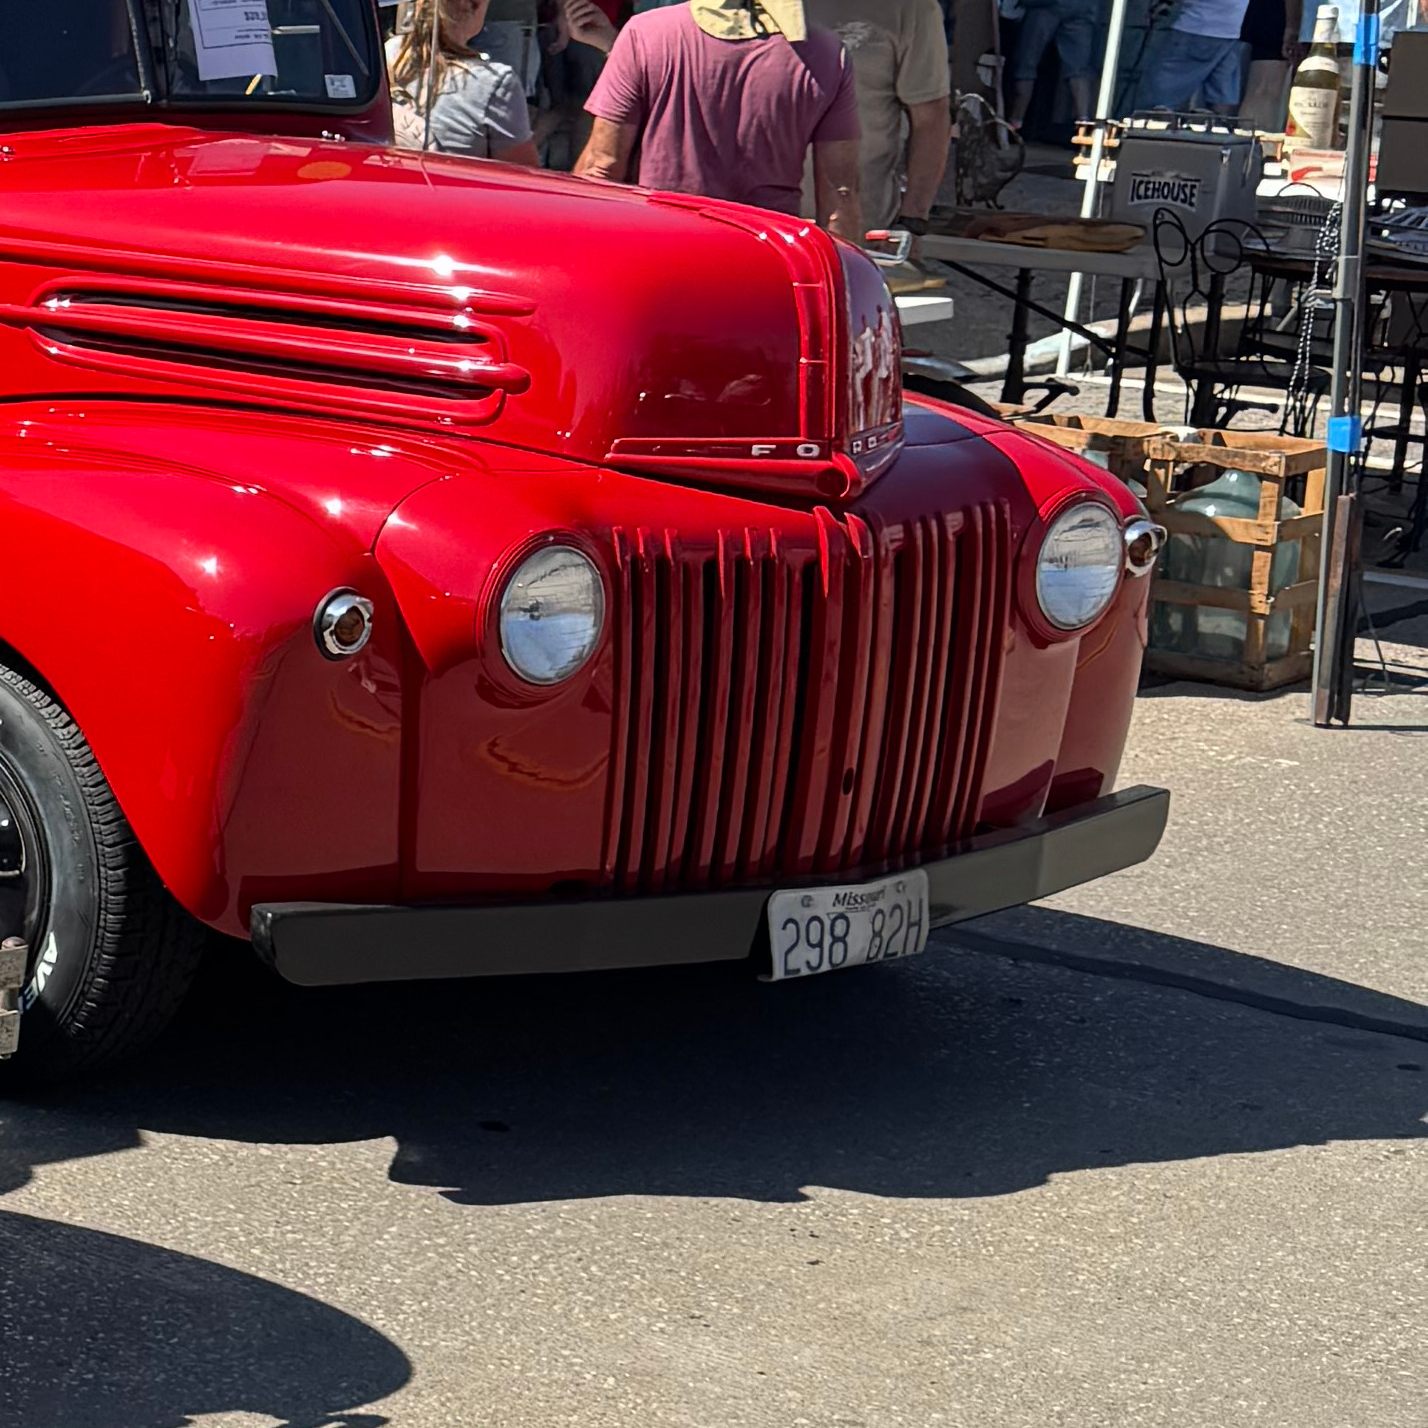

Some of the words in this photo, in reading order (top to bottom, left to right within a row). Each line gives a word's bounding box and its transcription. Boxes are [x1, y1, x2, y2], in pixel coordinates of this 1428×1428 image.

[1130, 178, 1197, 208] ICEHOUSE
[782, 913, 851, 977] 298
[866, 896, 924, 962] 82H
